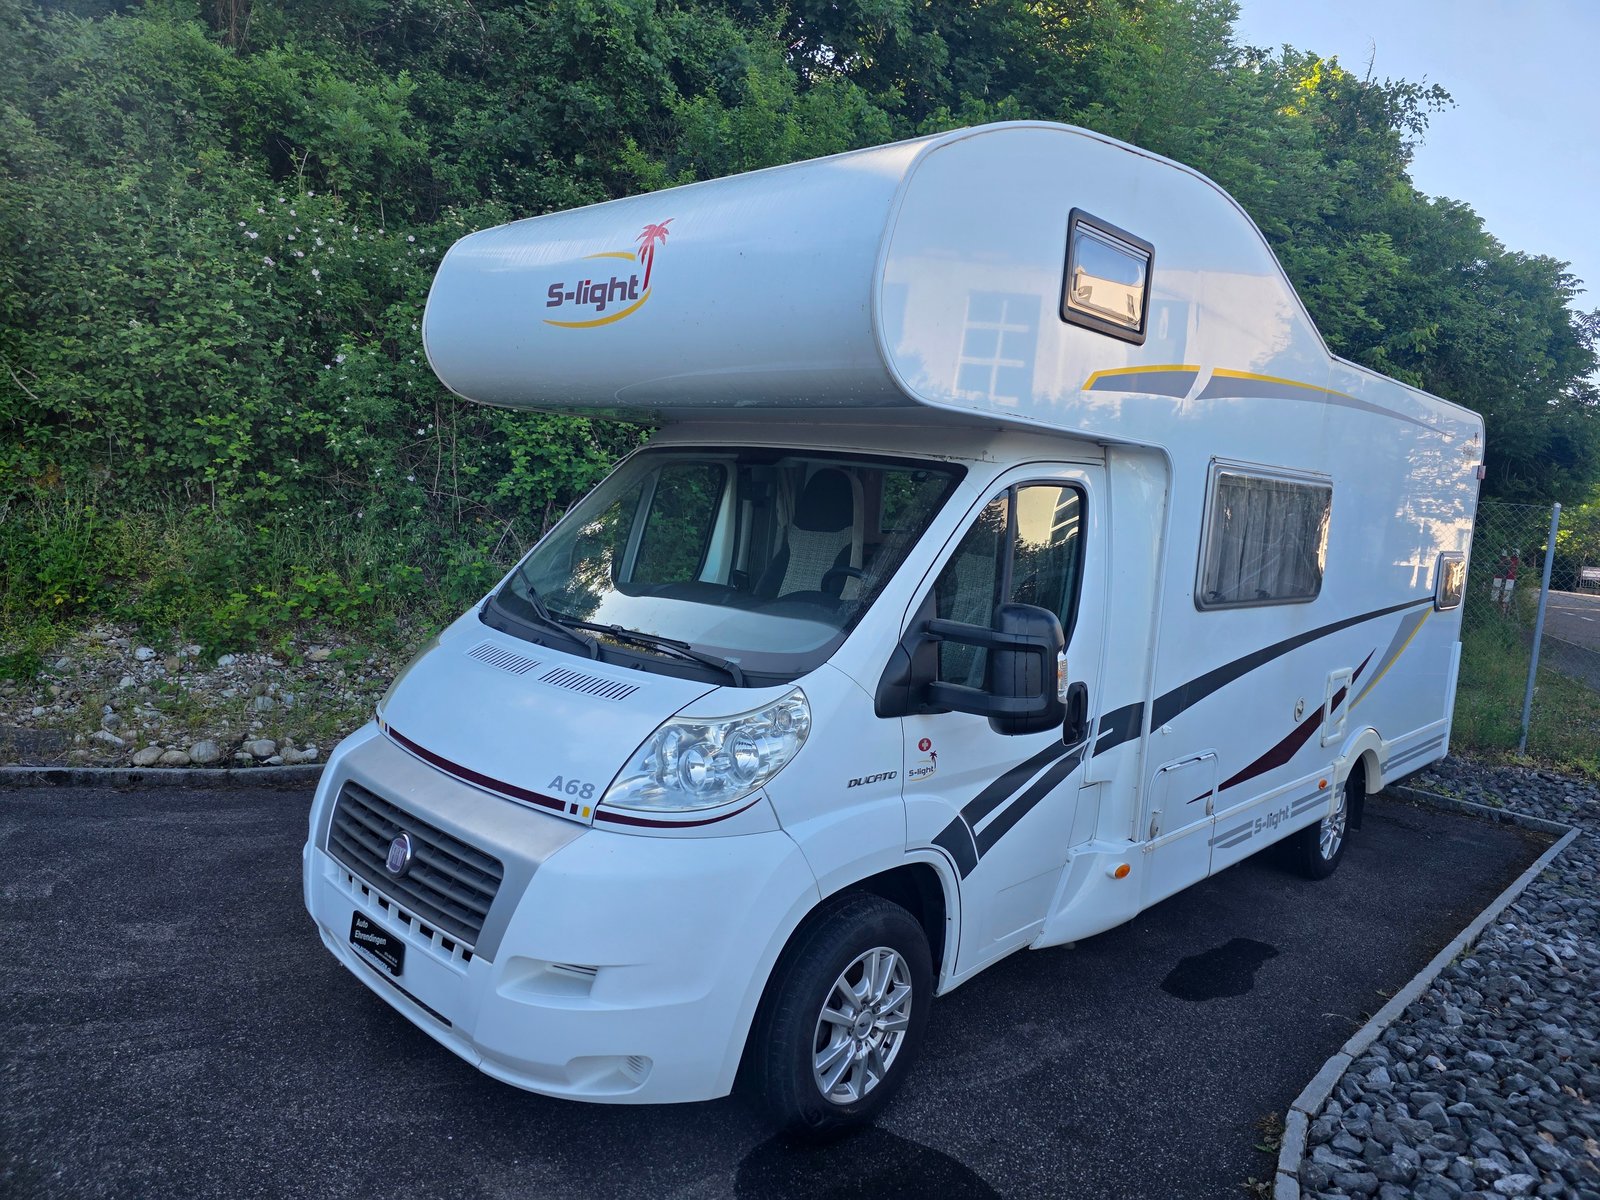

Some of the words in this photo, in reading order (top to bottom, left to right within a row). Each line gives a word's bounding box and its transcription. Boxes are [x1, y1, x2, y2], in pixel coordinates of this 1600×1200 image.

[546, 274, 639, 312] S-light
[847, 771, 897, 788] DUCATO
[908, 766, 934, 777] S-light
[547, 775, 596, 800] A68
[1254, 805, 1290, 835] S-light
[356, 918, 369, 929] Auto
